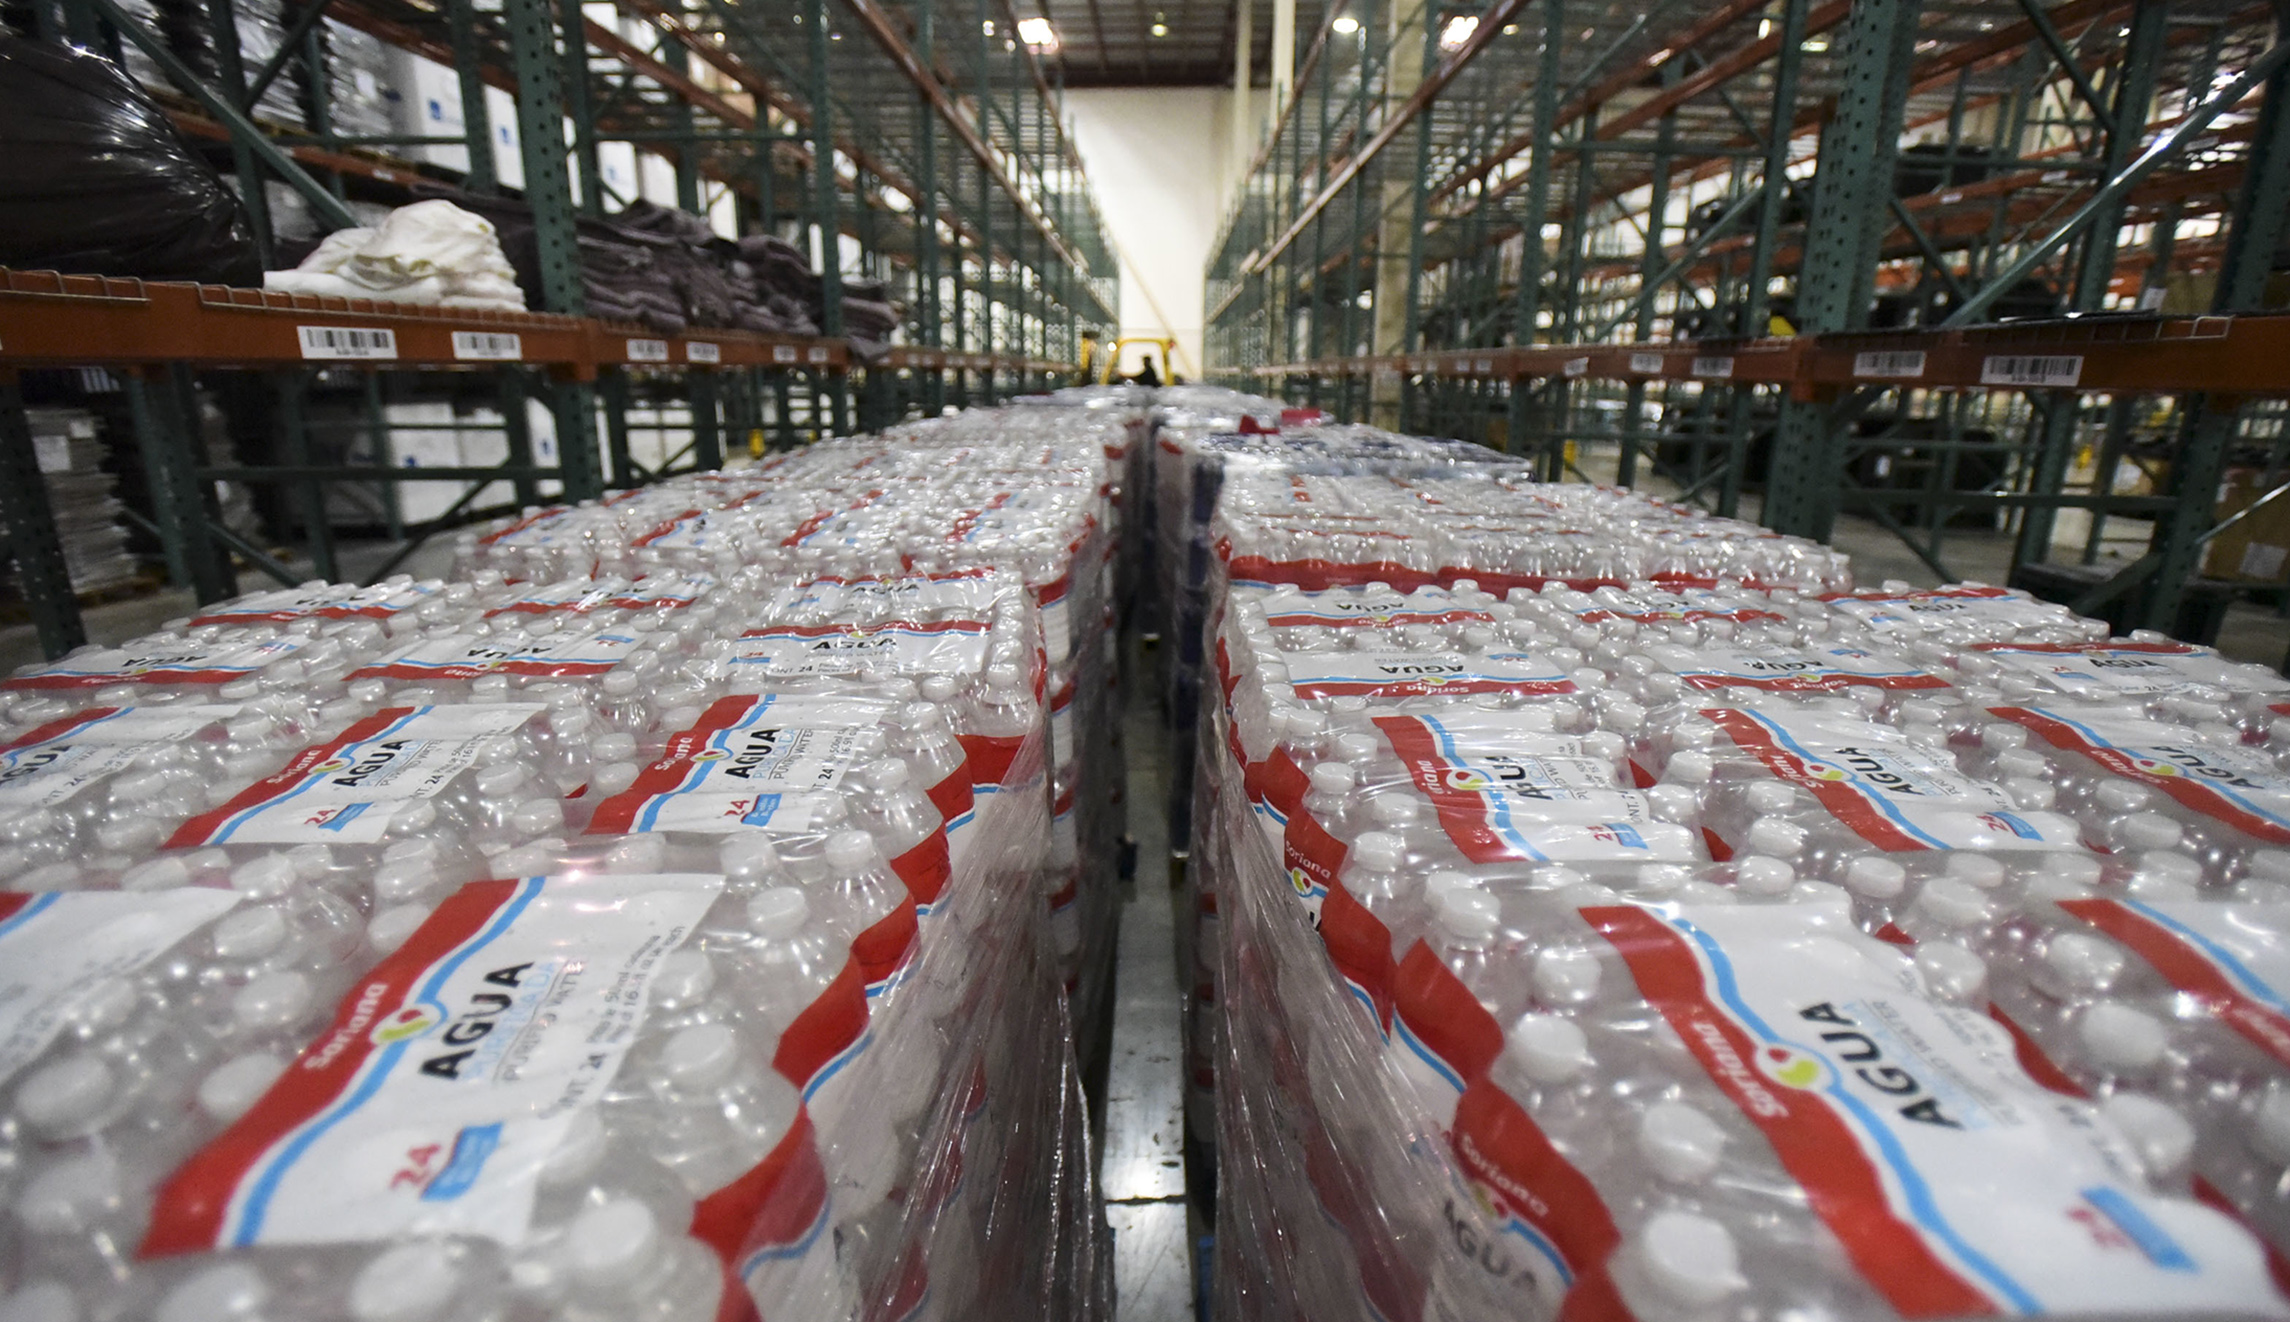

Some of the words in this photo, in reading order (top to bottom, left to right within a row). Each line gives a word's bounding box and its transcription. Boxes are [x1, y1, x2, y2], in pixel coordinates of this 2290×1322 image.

[811, 637, 897, 650] AGUA
[1379, 665, 1465, 674] AGUA
[332, 739, 413, 788] AGUA
[725, 728, 782, 779] AGUA
[818, 768, 835, 780] 24
[1834, 746, 1926, 796] AGUA
[418, 961, 535, 1080] AGUA
[1799, 1001, 1967, 1131] AGUA
